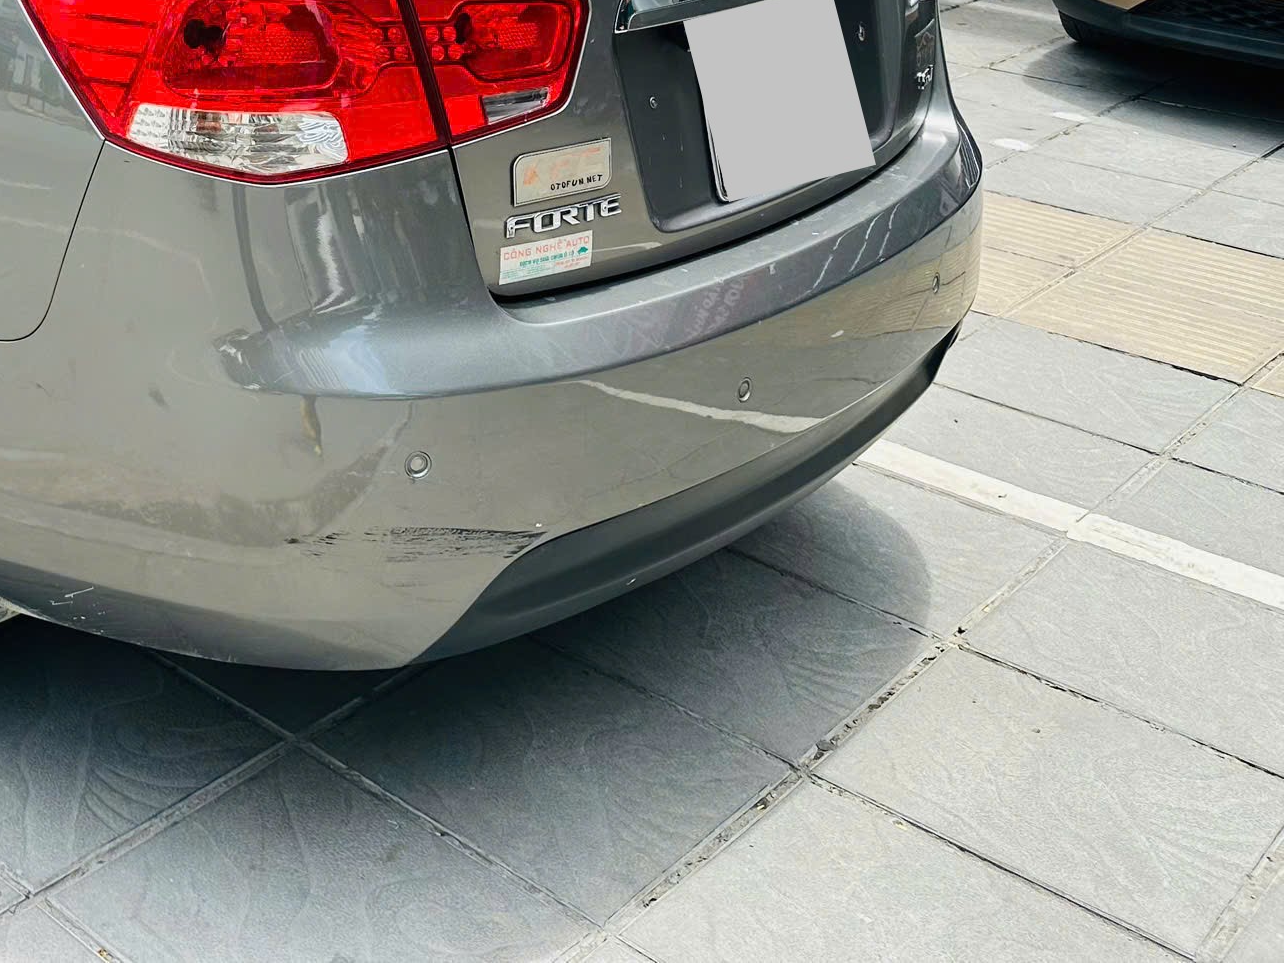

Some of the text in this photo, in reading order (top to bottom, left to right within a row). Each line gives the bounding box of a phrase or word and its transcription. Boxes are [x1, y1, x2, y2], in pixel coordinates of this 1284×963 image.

[505, 193, 622, 239] FORTE
[503, 248, 532, 261] CÔNG
[566, 236, 590, 248] AUTO
